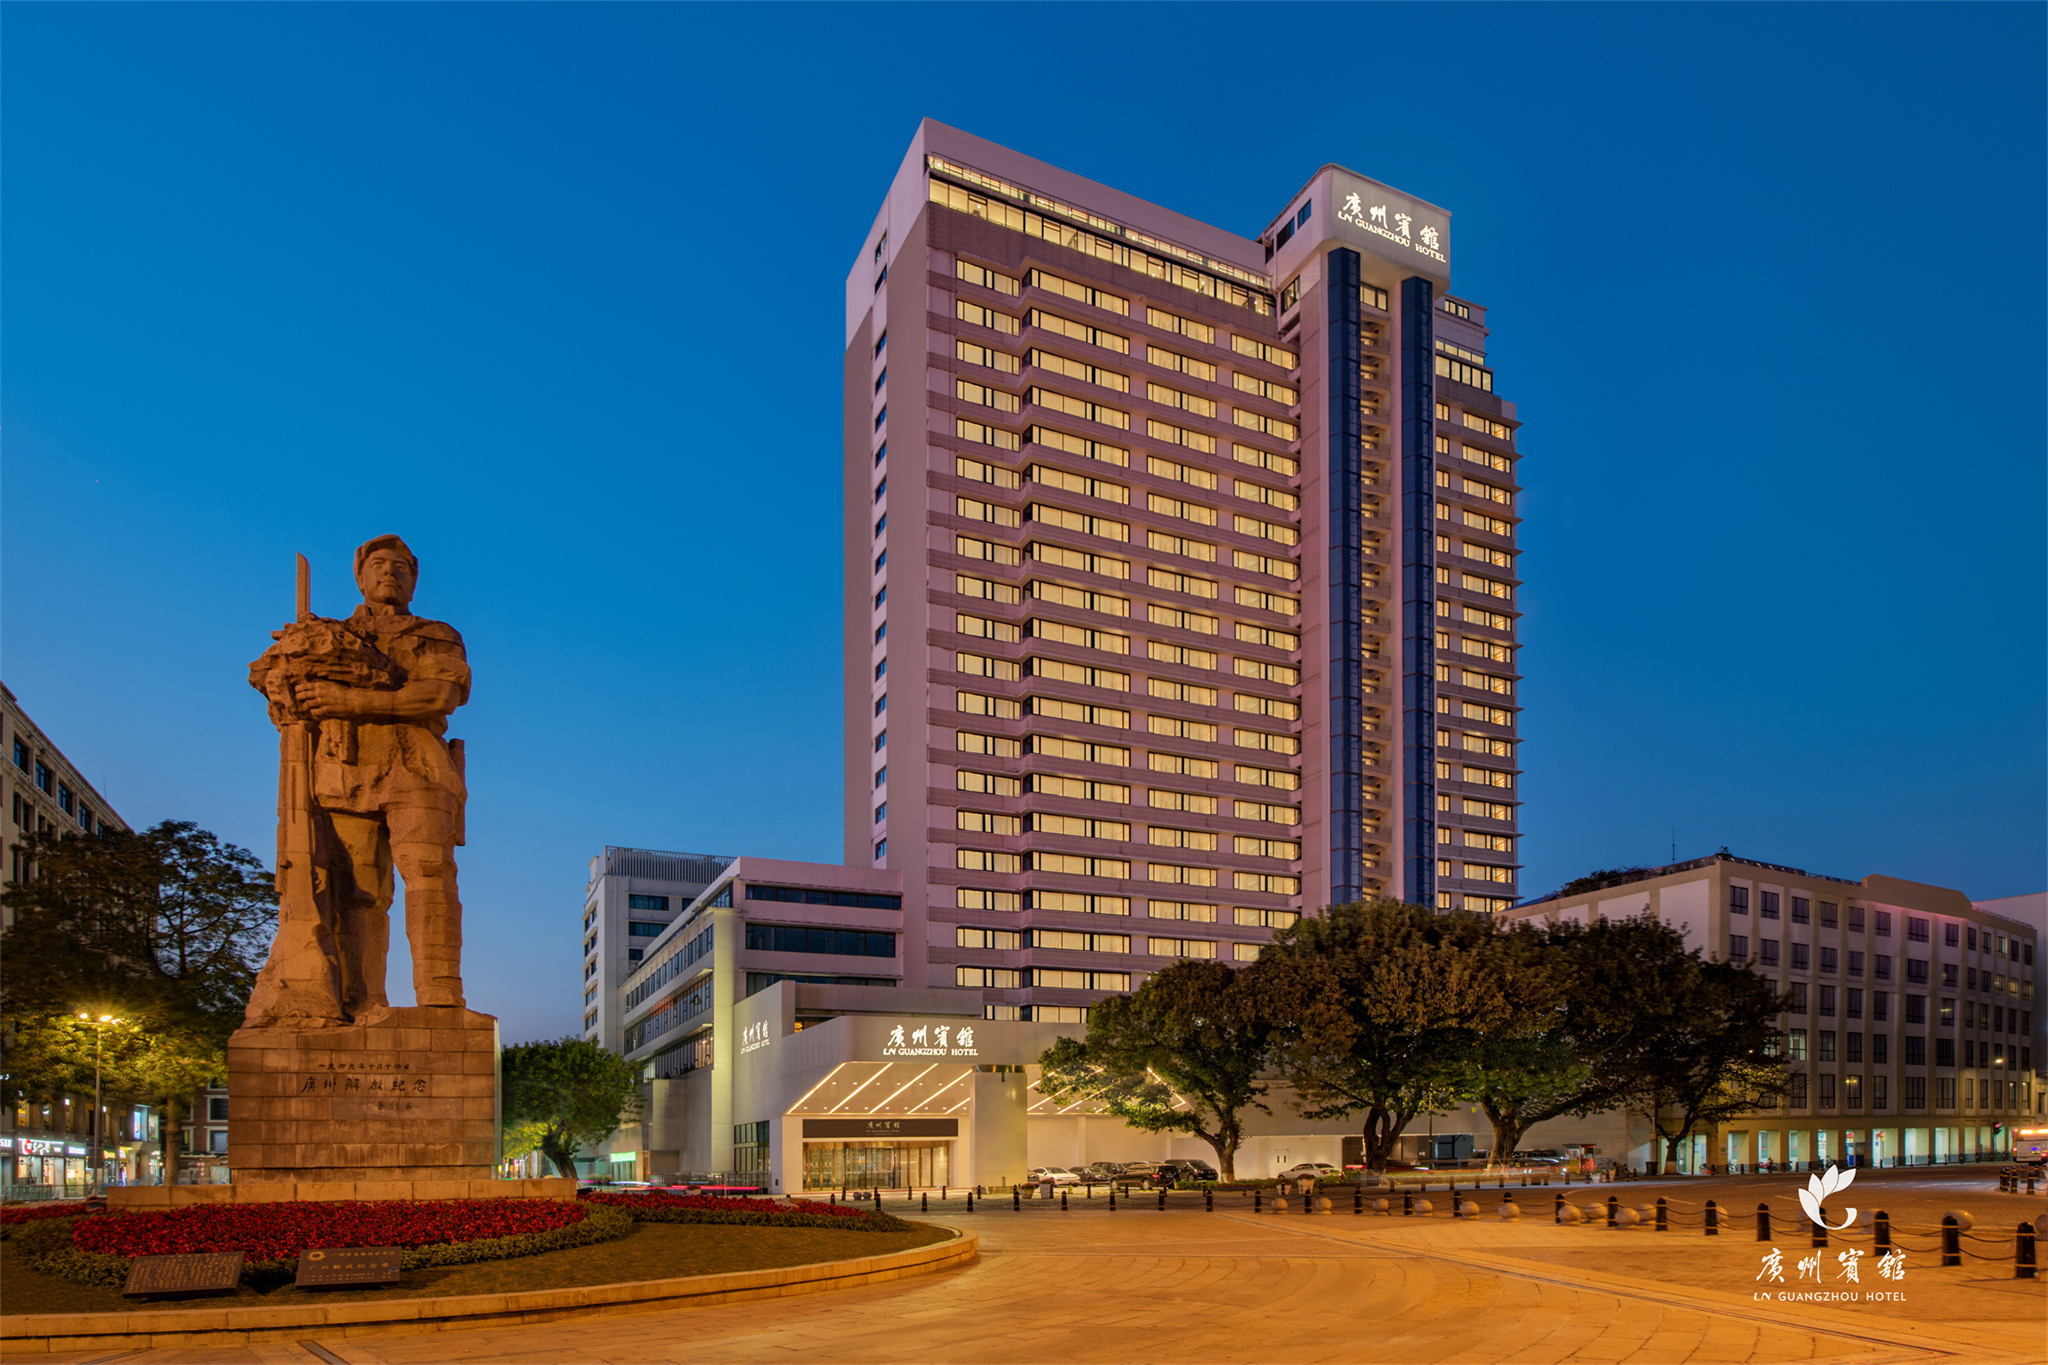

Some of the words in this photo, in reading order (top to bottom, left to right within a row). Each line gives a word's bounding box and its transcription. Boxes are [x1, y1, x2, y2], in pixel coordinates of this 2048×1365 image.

[1338, 210, 1353, 223] LN
[1355, 218, 1411, 248] GUANGZHOU
[1415, 243, 1447, 263] HOTEL
[883, 1048, 896, 1056] LN
[898, 1048, 947, 1056] GUANGZHOU
[951, 1048, 979, 1056] HOTEL
